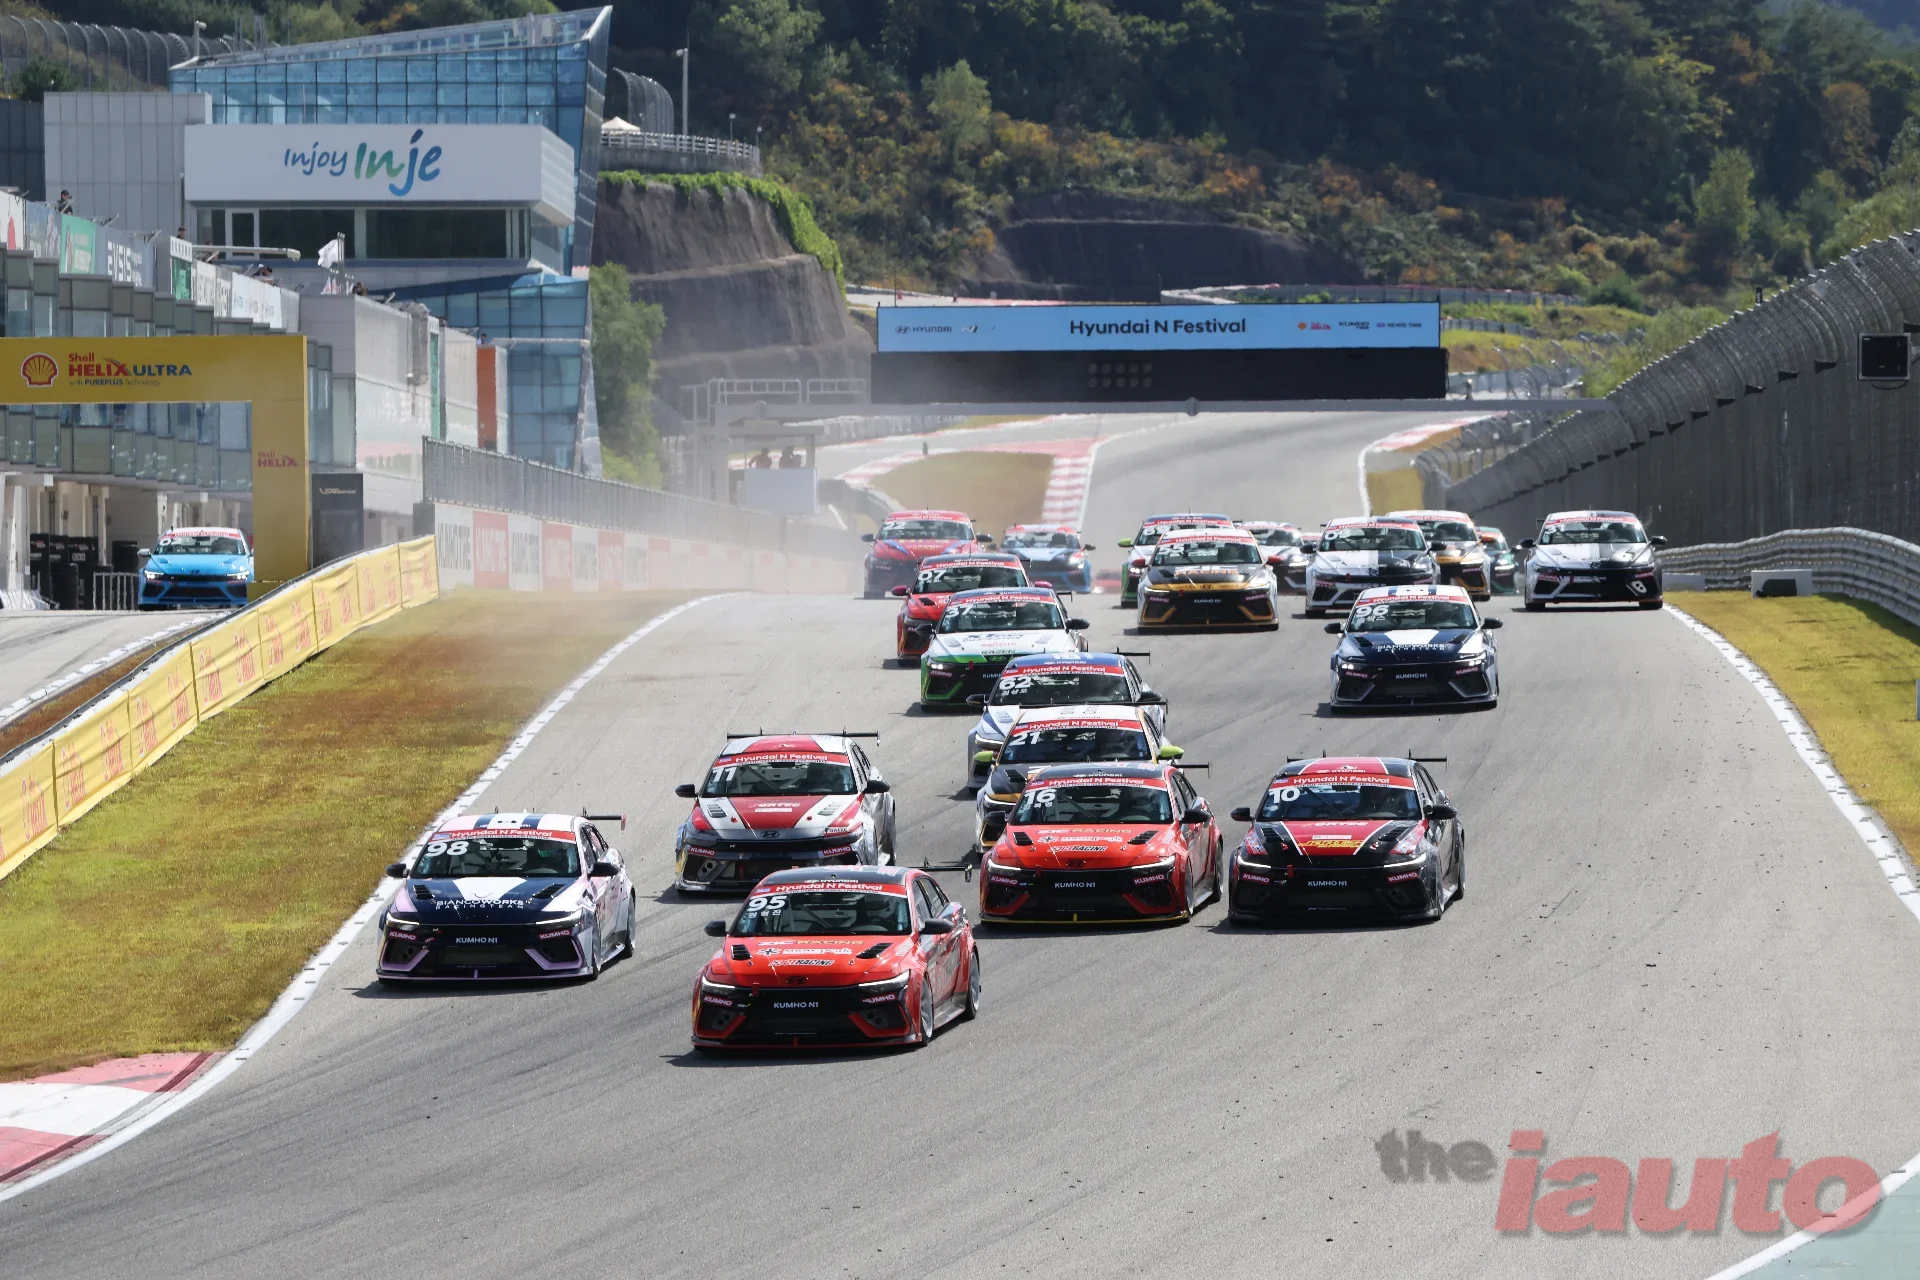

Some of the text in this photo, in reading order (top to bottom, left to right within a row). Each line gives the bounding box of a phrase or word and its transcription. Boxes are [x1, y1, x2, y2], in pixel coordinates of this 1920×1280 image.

[284, 128, 442, 196] Injoy Inje
[1070, 318, 1246, 337] Hyundai N Festival
[68, 352, 94, 362] Shell
[68, 362, 192, 377] HELIX ULTRA
[125, 379, 160, 387] Technology
[258, 456, 298, 468] HELIX
[882, 522, 906, 530] 22
[918, 570, 946, 581] 07
[966, 596, 999, 604] Hyundai
[946, 604, 974, 618] 37
[1355, 604, 1390, 617] 96
[1022, 666, 1060, 675] Hyundai
[999, 676, 1032, 690] 62
[1030, 721, 1069, 730] Hyundai
[1009, 731, 1041, 746] 21
[736, 754, 777, 763] Hyundai
[712, 767, 737, 781] 11
[1049, 778, 1092, 786] Hyundai
[1294, 777, 1337, 785] Hyundai
[1350, 776, 1389, 784] Festival
[1024, 789, 1057, 806] 16
[1269, 788, 1300, 803] 10
[451, 829, 497, 839] Hyundai
[427, 841, 470, 857] 98
[690, 847, 715, 855] KUMHO
[991, 877, 1017, 885] KUMHO
[1134, 875, 1165, 884] KUMHO
[1242, 874, 1269, 883] KUMHO
[1389, 872, 1417, 882] KUMHO
[776, 883, 824, 892] Hyundai
[837, 883, 882, 891] Festival
[747, 895, 787, 912] 95
[389, 932, 416, 940] KUMHO
[539, 930, 570, 940] KUMHO
[704, 996, 732, 1006] KUMHO
